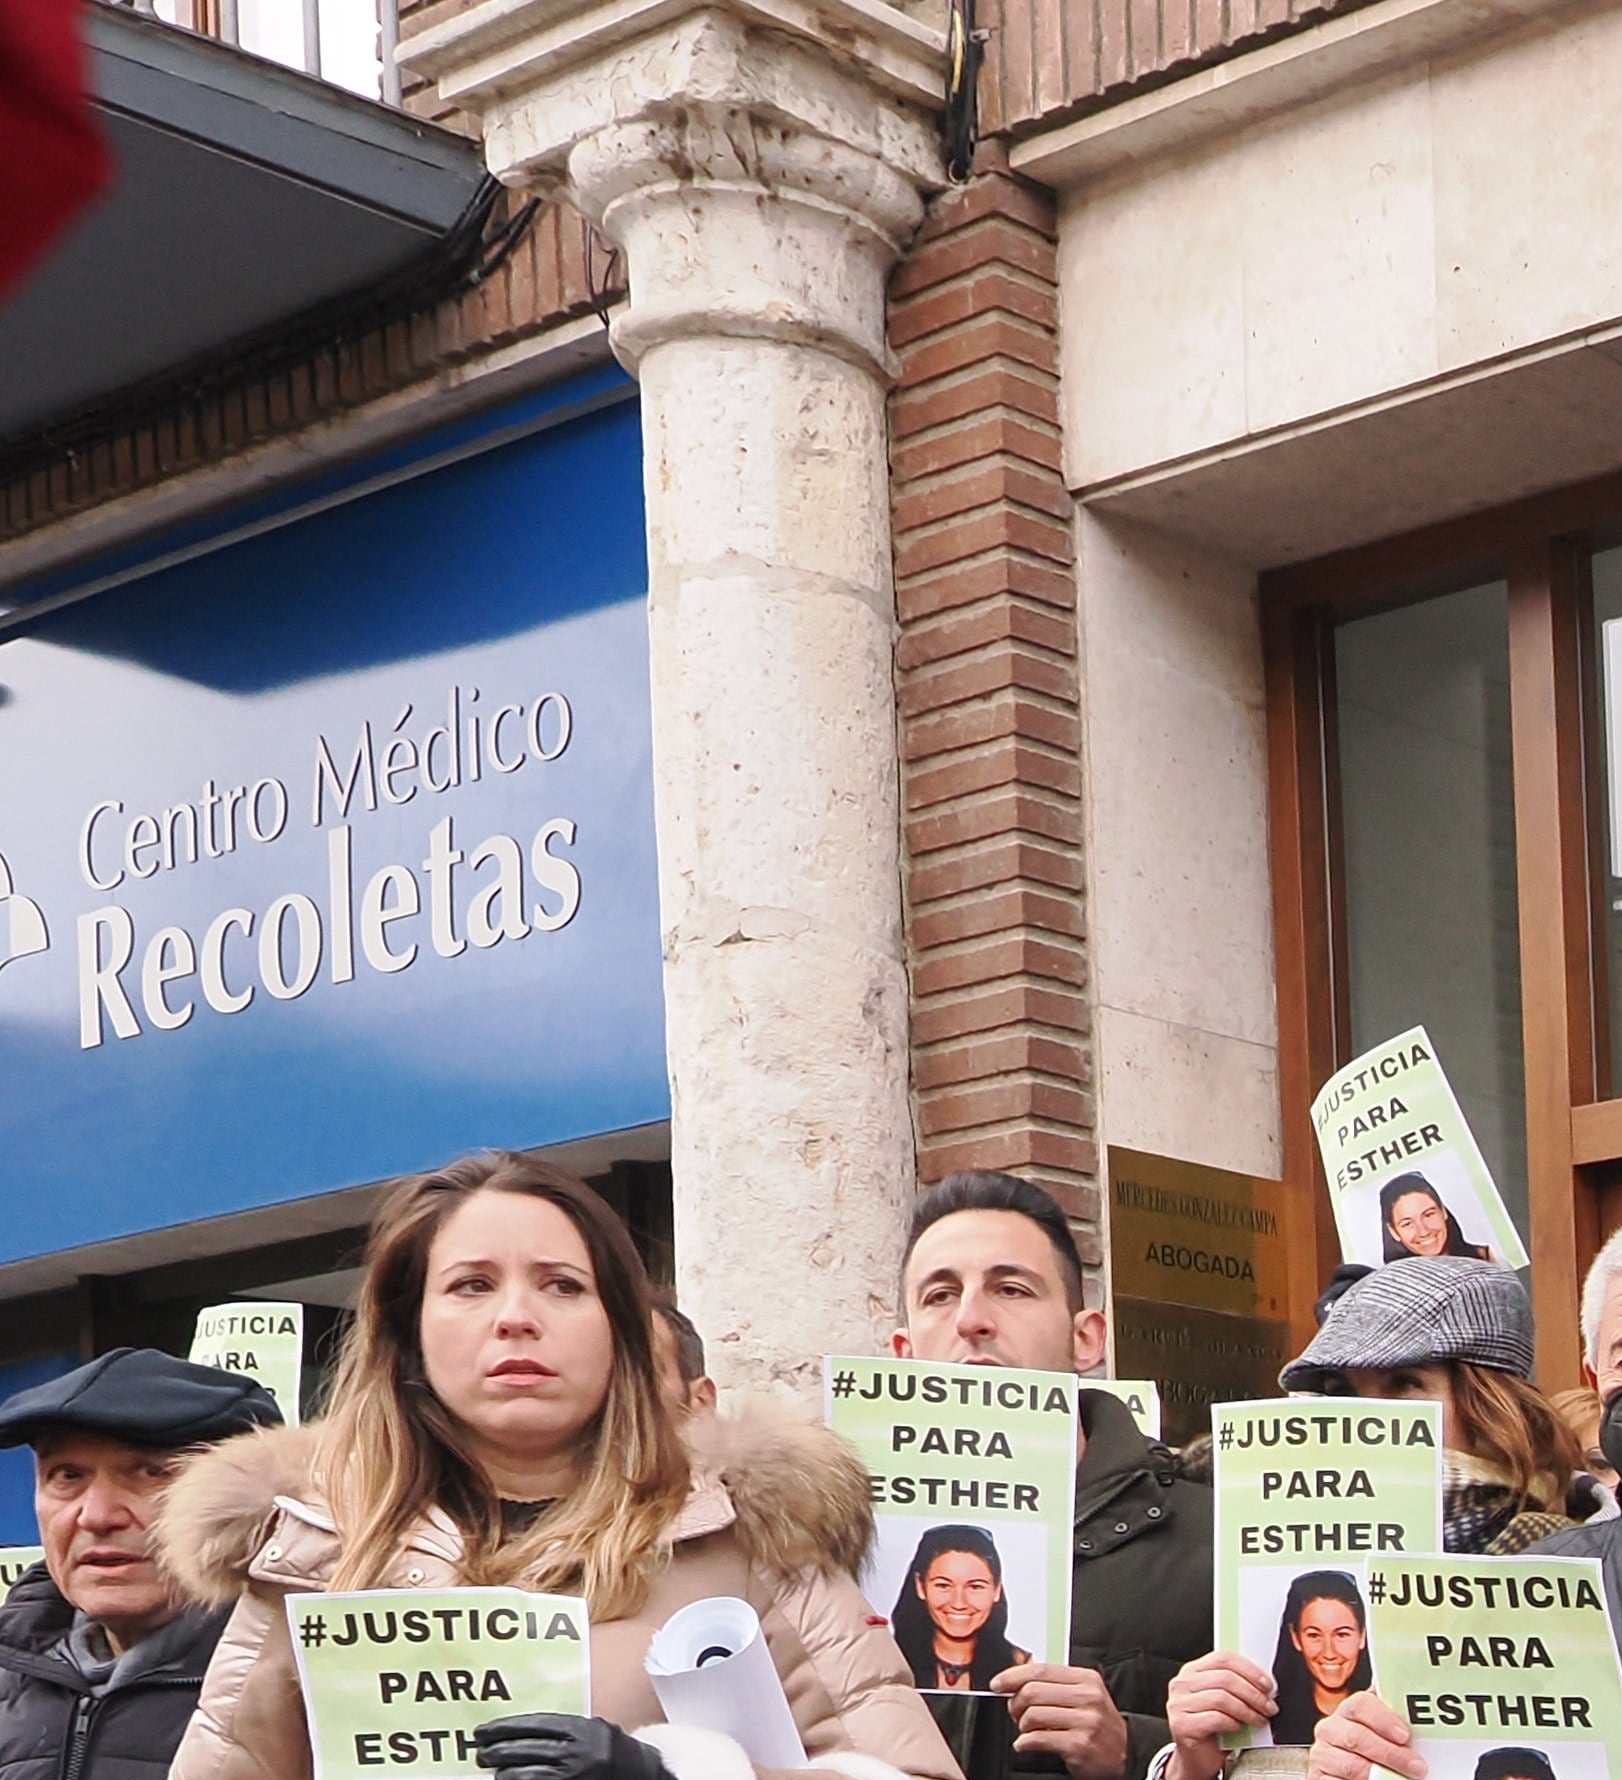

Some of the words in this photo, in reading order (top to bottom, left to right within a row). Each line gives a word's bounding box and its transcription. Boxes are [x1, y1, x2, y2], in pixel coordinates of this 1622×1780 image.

[79, 776, 289, 891] Centro
[311, 686, 574, 827] Médico
[76, 816, 583, 1050] Recoletas
[1338, 1097, 1408, 1147] PARA
[1337, 1124, 1444, 1190] ESTHER
[1146, 1242, 1256, 1282] ABOGADA
[198, 1316, 297, 1339] JUSTICIA
[832, 1371, 1071, 1414] #JUSTICIA
[893, 1426, 1013, 1459] PARA
[1219, 1415, 1434, 1452] #JUSTICIA
[1261, 1469, 1376, 1500] PARA
[1240, 1522, 1406, 1555] ESTHER
[1369, 1574, 1604, 1611] #JUSTICIA
[300, 1608, 581, 1648] #JUSTICIA
[1427, 1634, 1555, 1670] PARA
[380, 1670, 511, 1704] PARA
[1408, 1693, 1593, 1729] ESTHER
[355, 1730, 478, 1765] ESTH
